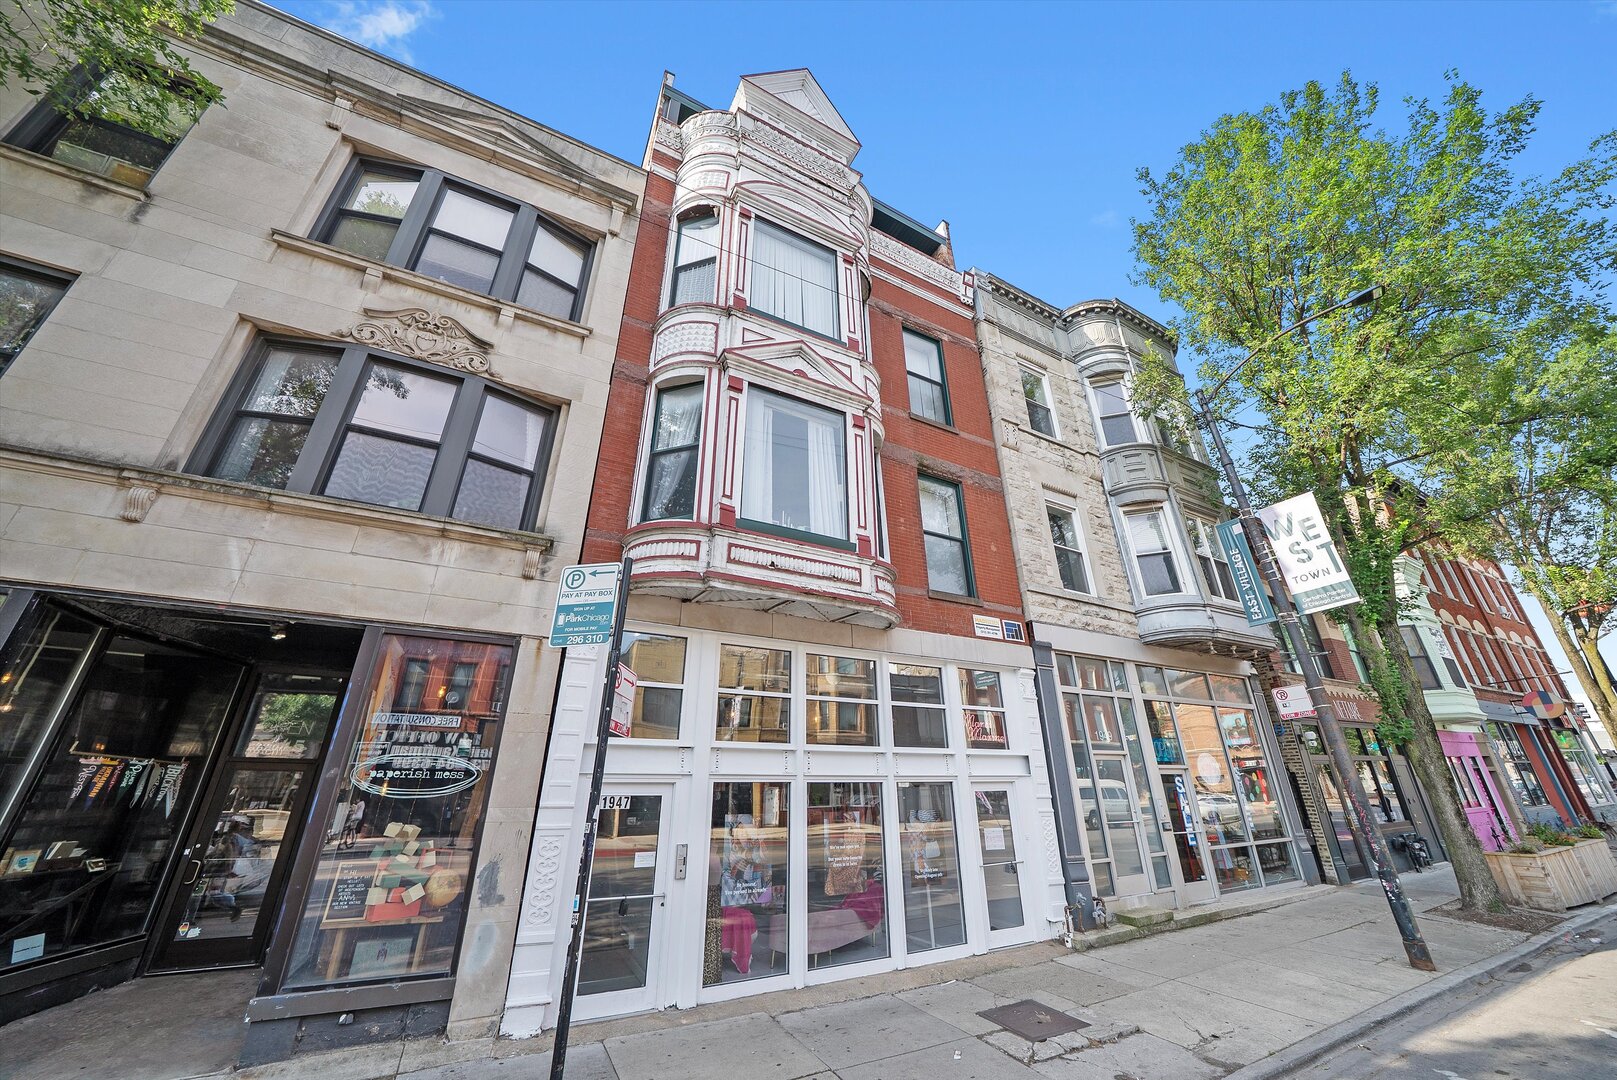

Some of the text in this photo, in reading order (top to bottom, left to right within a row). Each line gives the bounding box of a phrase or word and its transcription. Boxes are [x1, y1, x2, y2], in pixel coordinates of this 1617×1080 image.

[1291, 567, 1331, 584] TOWN
[1229, 548, 1262, 619] EAST VILLAGE
[1307, 598, 1330, 608] Chicago
[1330, 592, 1352, 601] Central
[565, 613, 609, 623] ParkChicago
[567, 636, 584, 645] 296
[585, 634, 603, 643] 310
[368, 767, 465, 781] paperish mess
[601, 796, 630, 809] 1947
[1174, 776, 1198, 847] SALE
